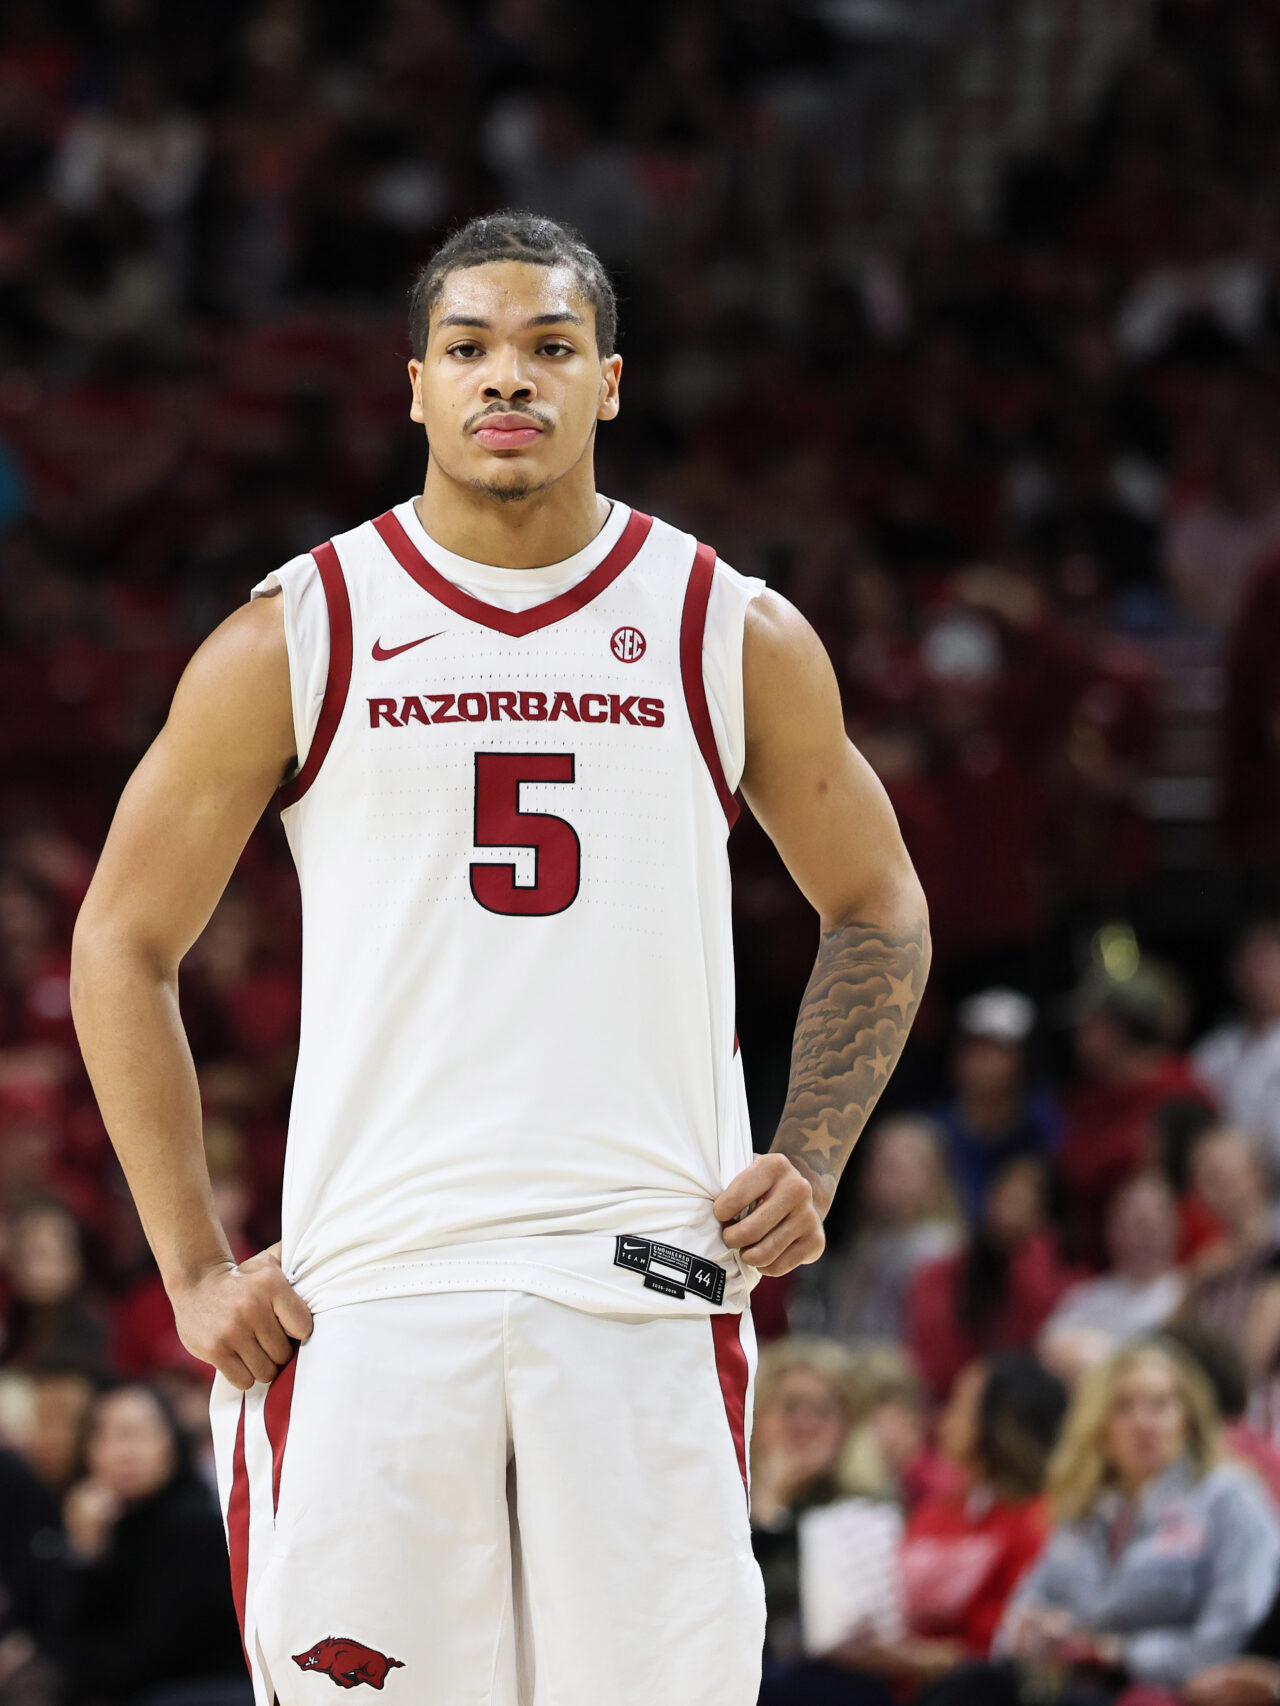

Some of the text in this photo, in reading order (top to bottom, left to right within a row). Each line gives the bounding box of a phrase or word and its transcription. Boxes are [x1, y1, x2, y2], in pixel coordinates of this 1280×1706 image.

[613, 629, 644, 660] SEC
[367, 691, 665, 728] RAZORBACKS
[470, 752, 580, 916] 5
[622, 1252, 646, 1264] TEAM
[694, 1269, 711, 1287] 44
